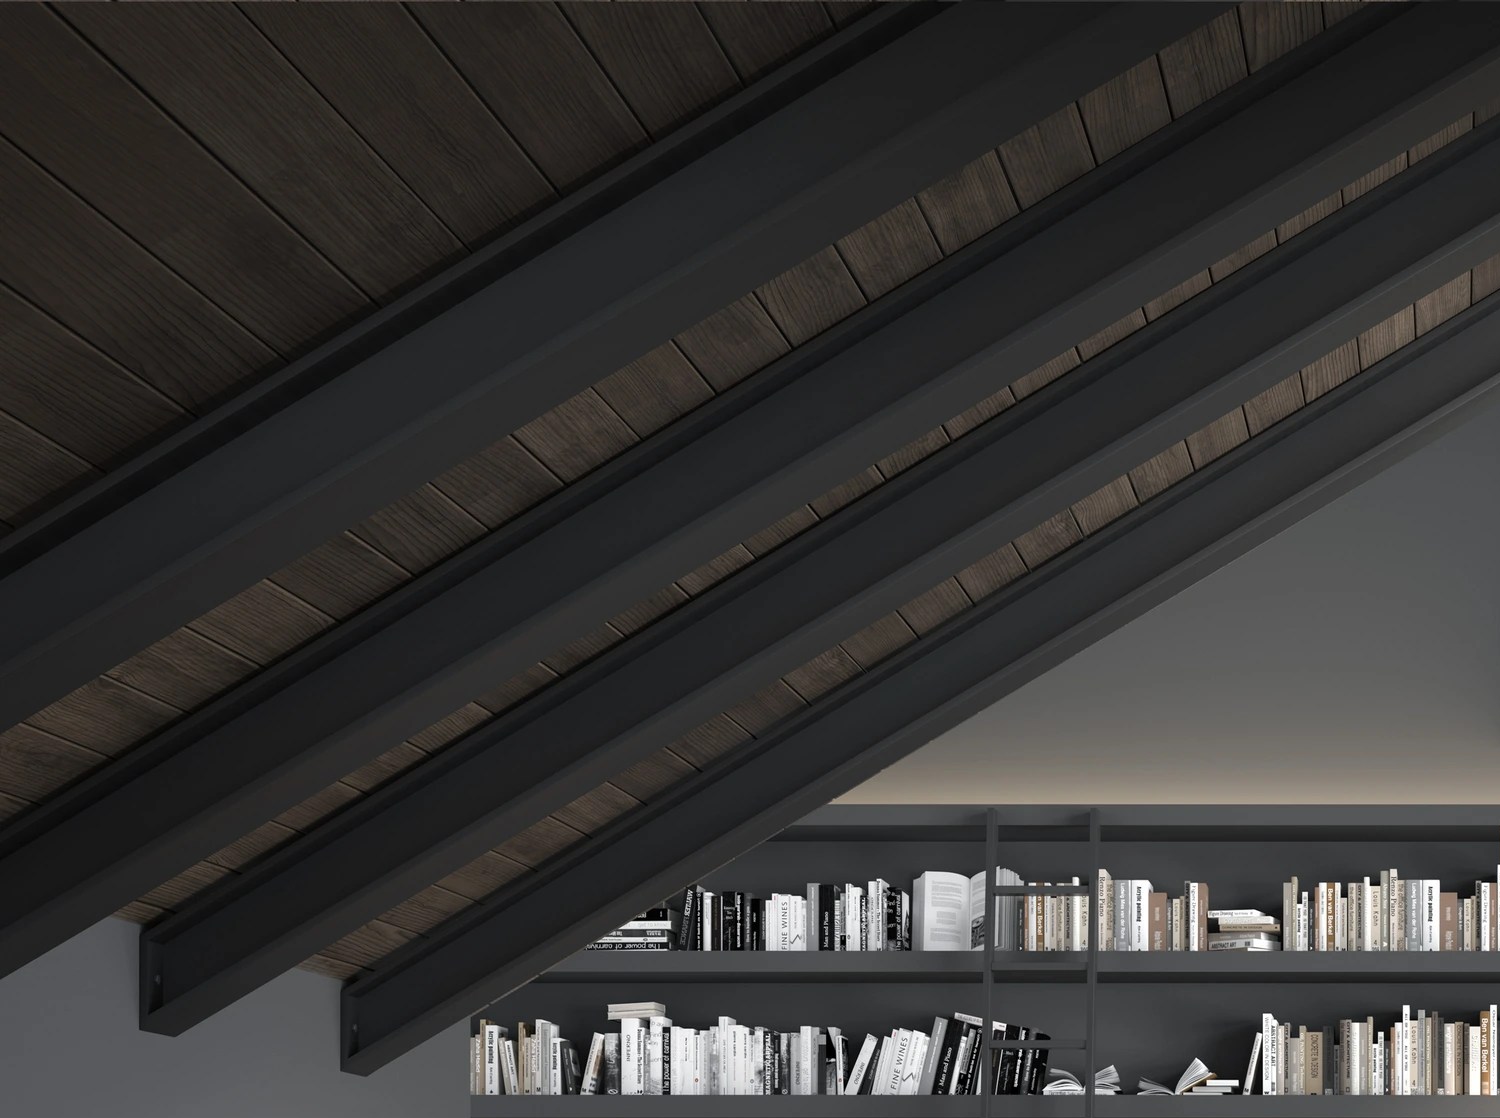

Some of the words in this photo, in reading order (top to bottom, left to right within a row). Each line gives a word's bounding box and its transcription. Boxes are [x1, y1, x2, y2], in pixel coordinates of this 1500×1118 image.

[895, 1037, 908, 1066] WINES
[1311, 1034, 1319, 1057] CONCRETE
[890, 1069, 901, 1090] FINE
[1311, 1062, 1319, 1078] DESIGN
